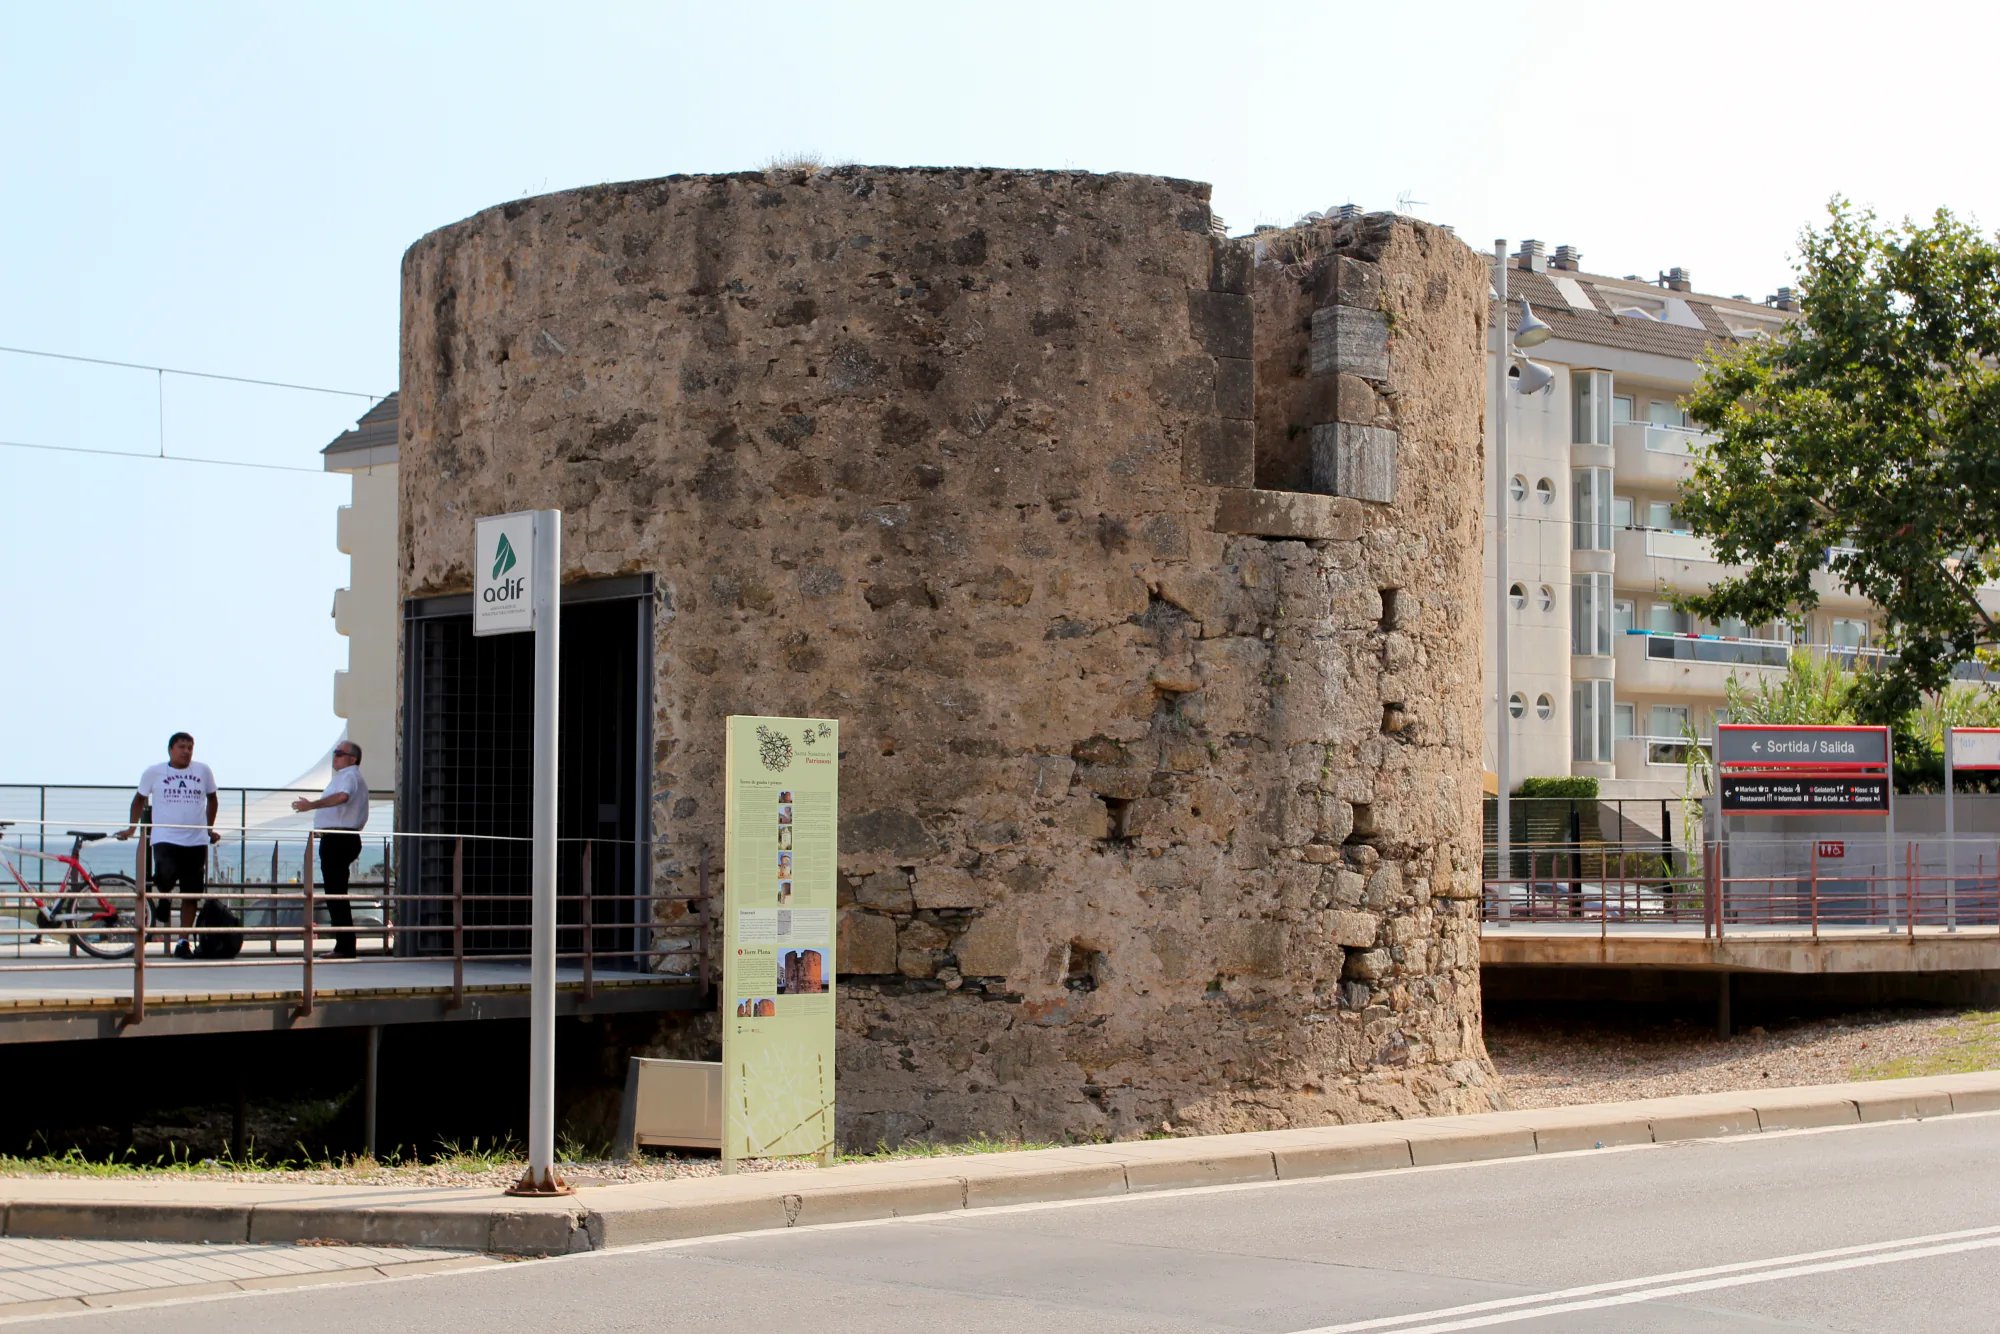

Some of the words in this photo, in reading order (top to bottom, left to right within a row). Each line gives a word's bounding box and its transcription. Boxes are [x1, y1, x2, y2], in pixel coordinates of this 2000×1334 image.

[483, 577, 525, 602] adif
[1767, 740, 1810, 753] Sortida
[1812, 740, 1818, 753] /
[1820, 740, 1855, 753] Salida
